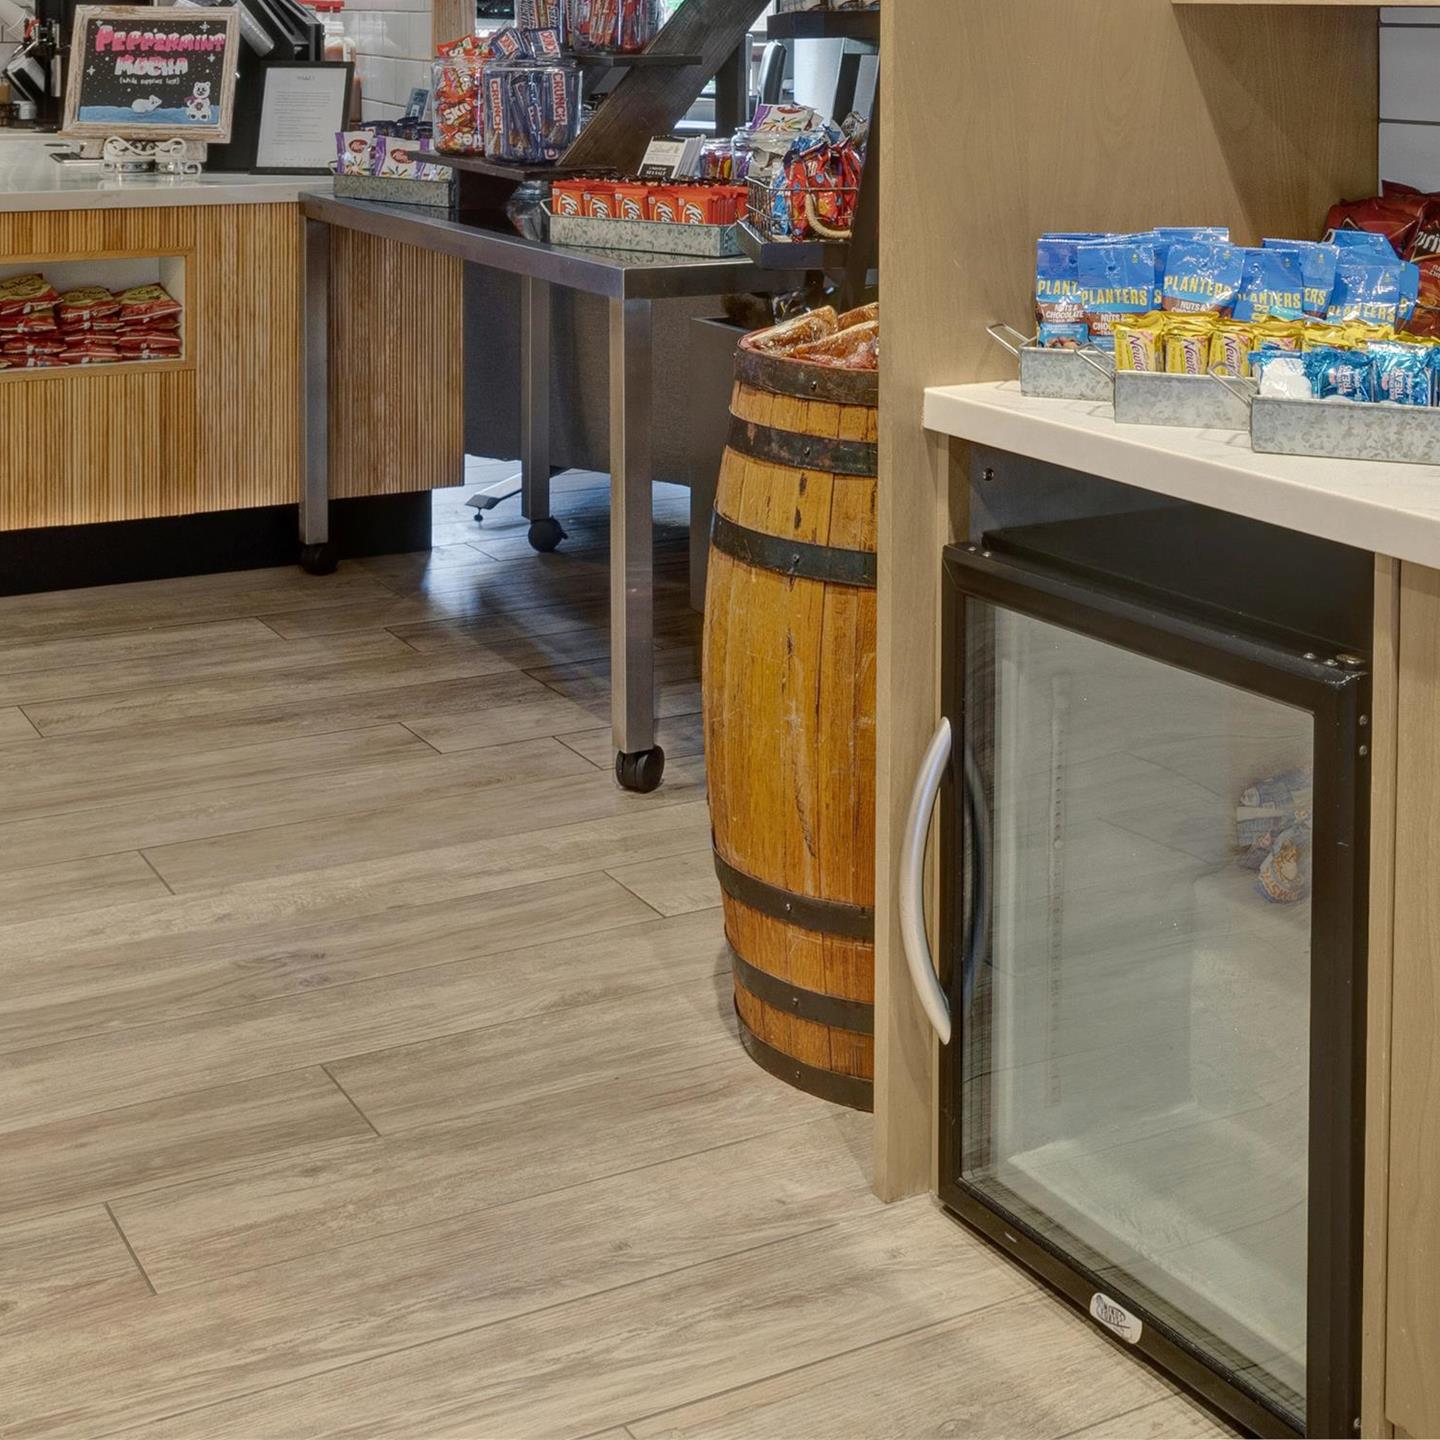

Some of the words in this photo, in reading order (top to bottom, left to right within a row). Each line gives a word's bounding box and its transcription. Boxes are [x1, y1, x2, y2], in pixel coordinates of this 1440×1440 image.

[95, 24, 226, 52] PEPPERMINT
[114, 54, 188, 76] MOCHA
[1081, 288, 1148, 306] PLANTERS
[1045, 310, 1084, 319] CHOCOLATE
